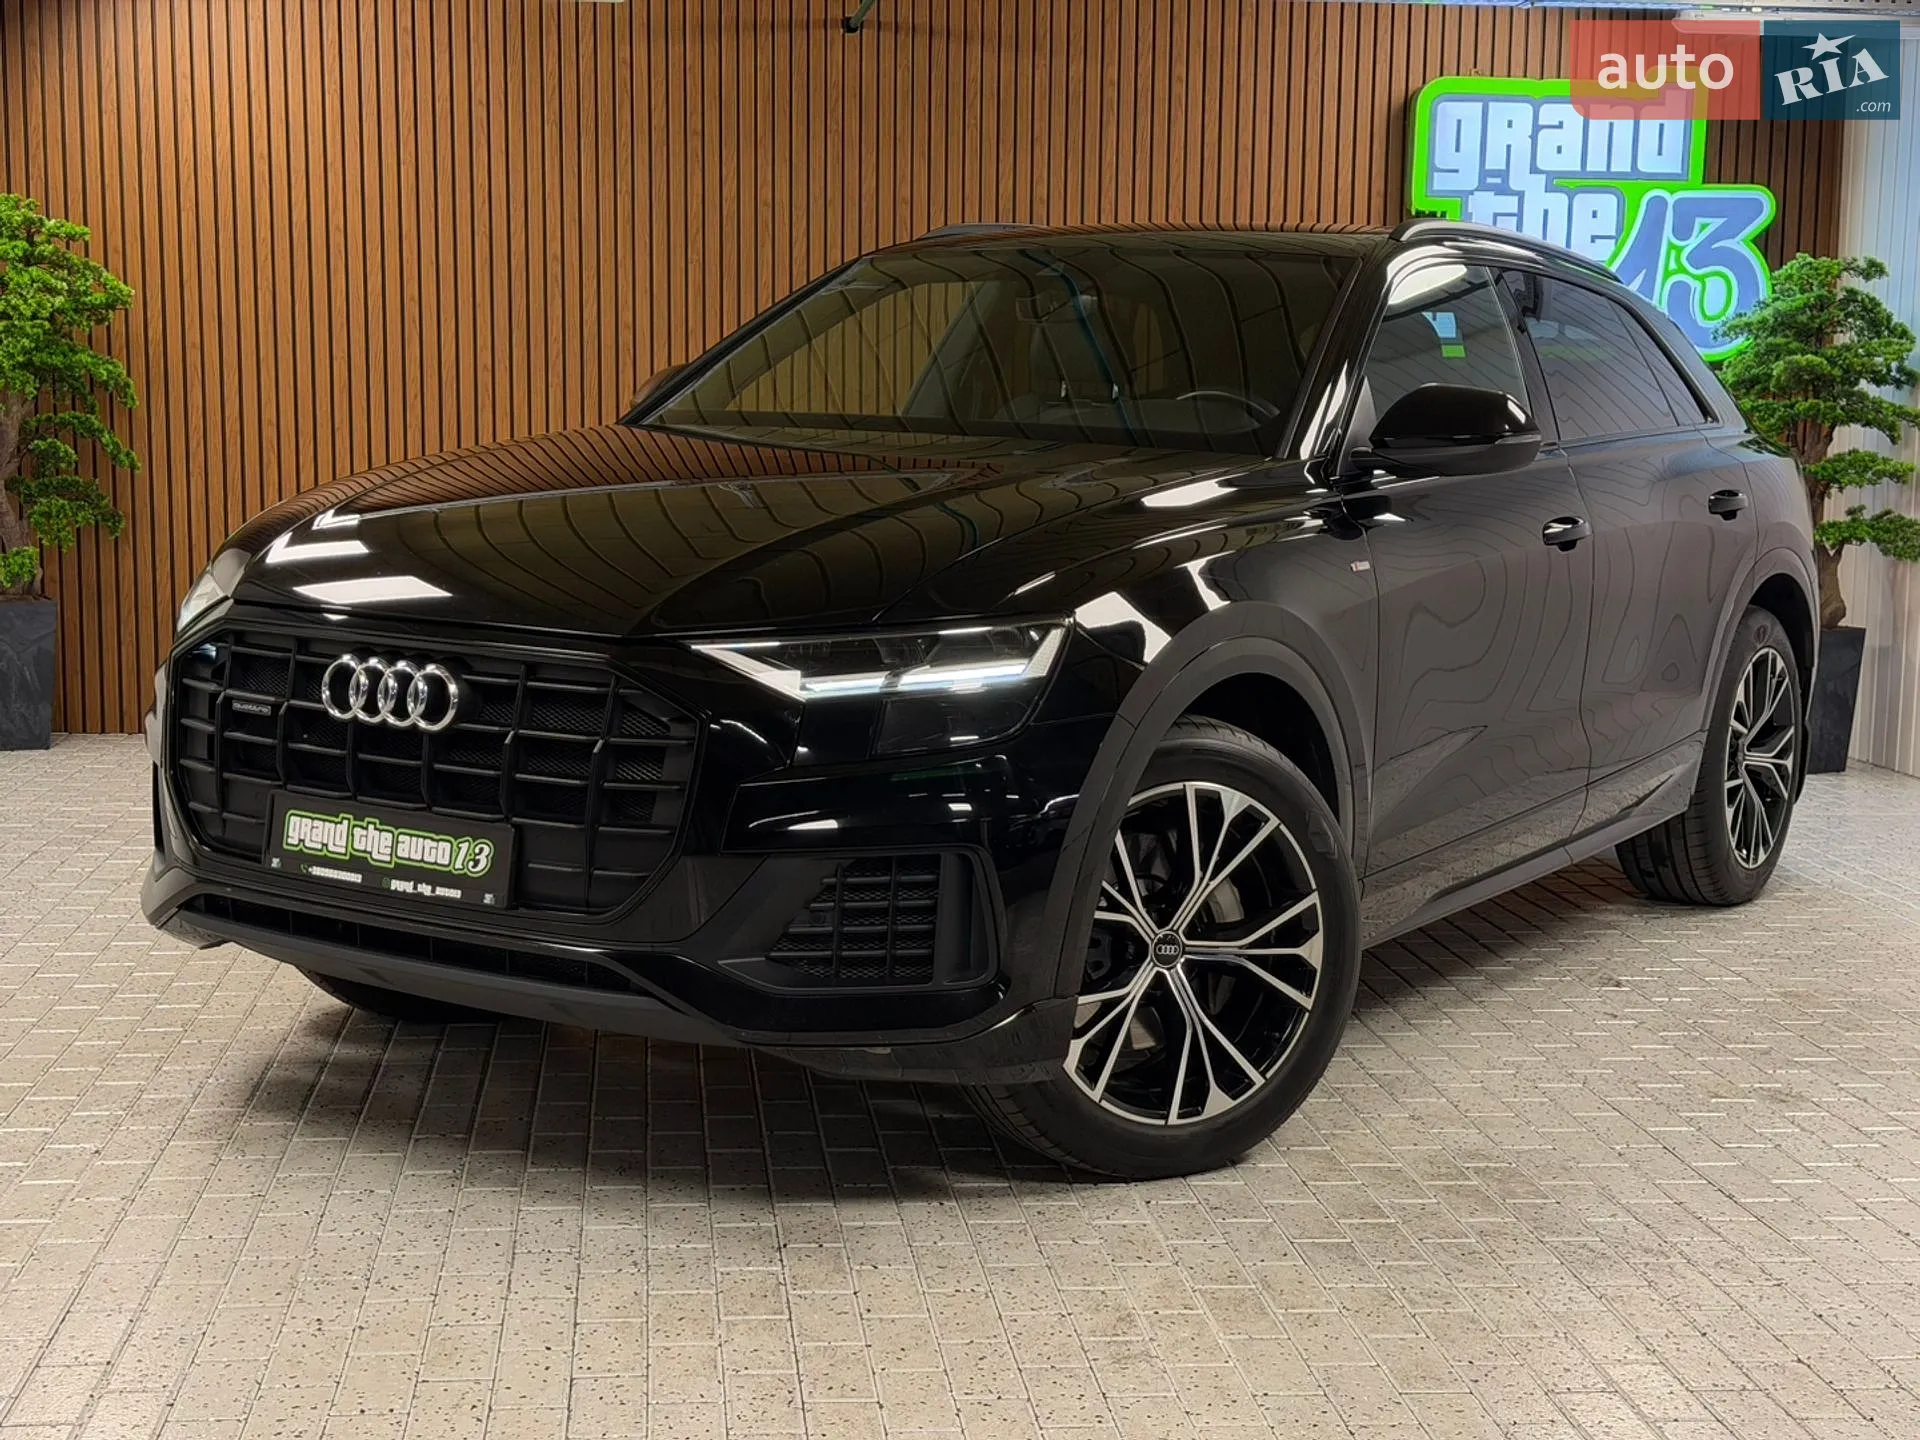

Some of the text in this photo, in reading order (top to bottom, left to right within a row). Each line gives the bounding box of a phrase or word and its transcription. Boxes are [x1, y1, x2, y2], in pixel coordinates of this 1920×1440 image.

[1610, 190, 1771, 352] 13
[353, 822, 394, 863] the
[453, 840, 493, 874] 13
